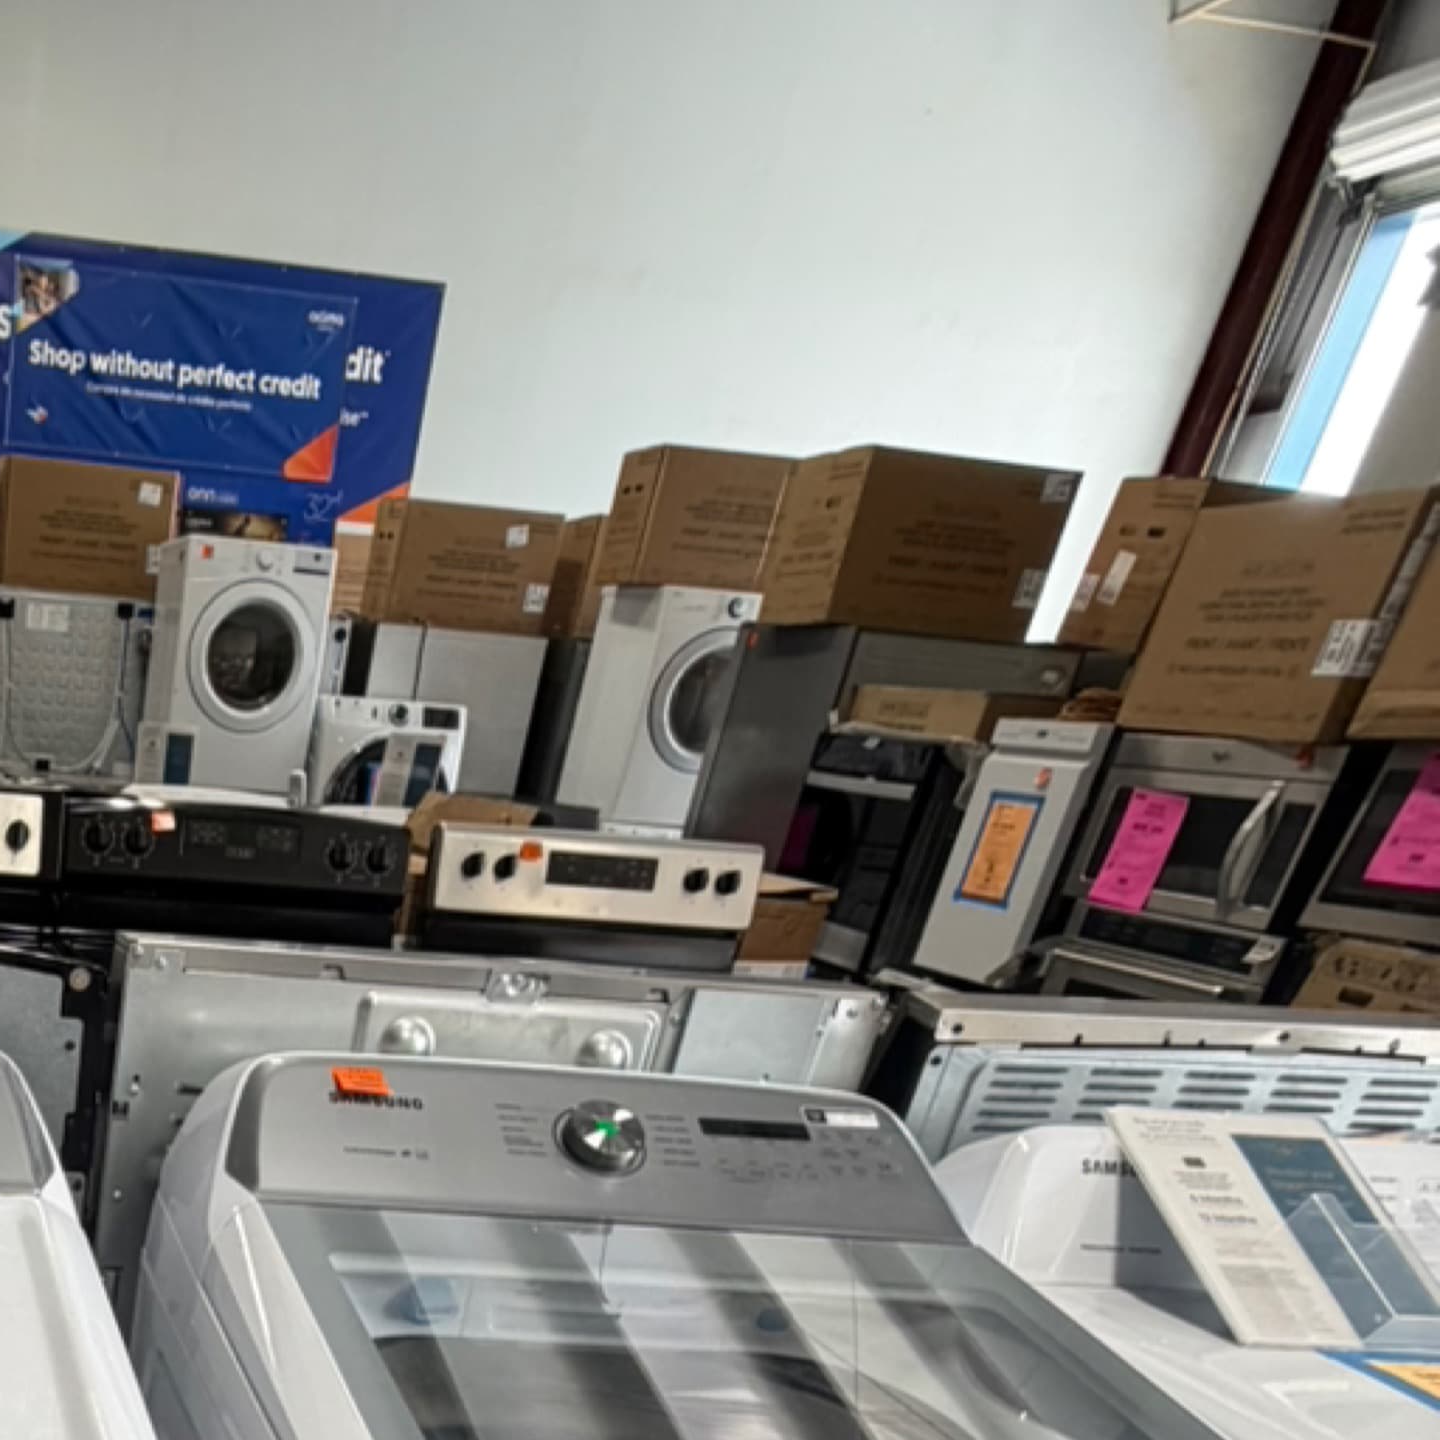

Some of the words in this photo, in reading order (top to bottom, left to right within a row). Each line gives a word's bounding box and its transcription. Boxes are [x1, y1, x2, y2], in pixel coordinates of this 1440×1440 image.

[28, 339, 86, 374] Shop
[89, 349, 174, 382] without
[177, 363, 256, 393] perfect
[259, 372, 322, 401] credit
[345, 344, 384, 384] dit
[1082, 1158, 1138, 1178] SAMS
